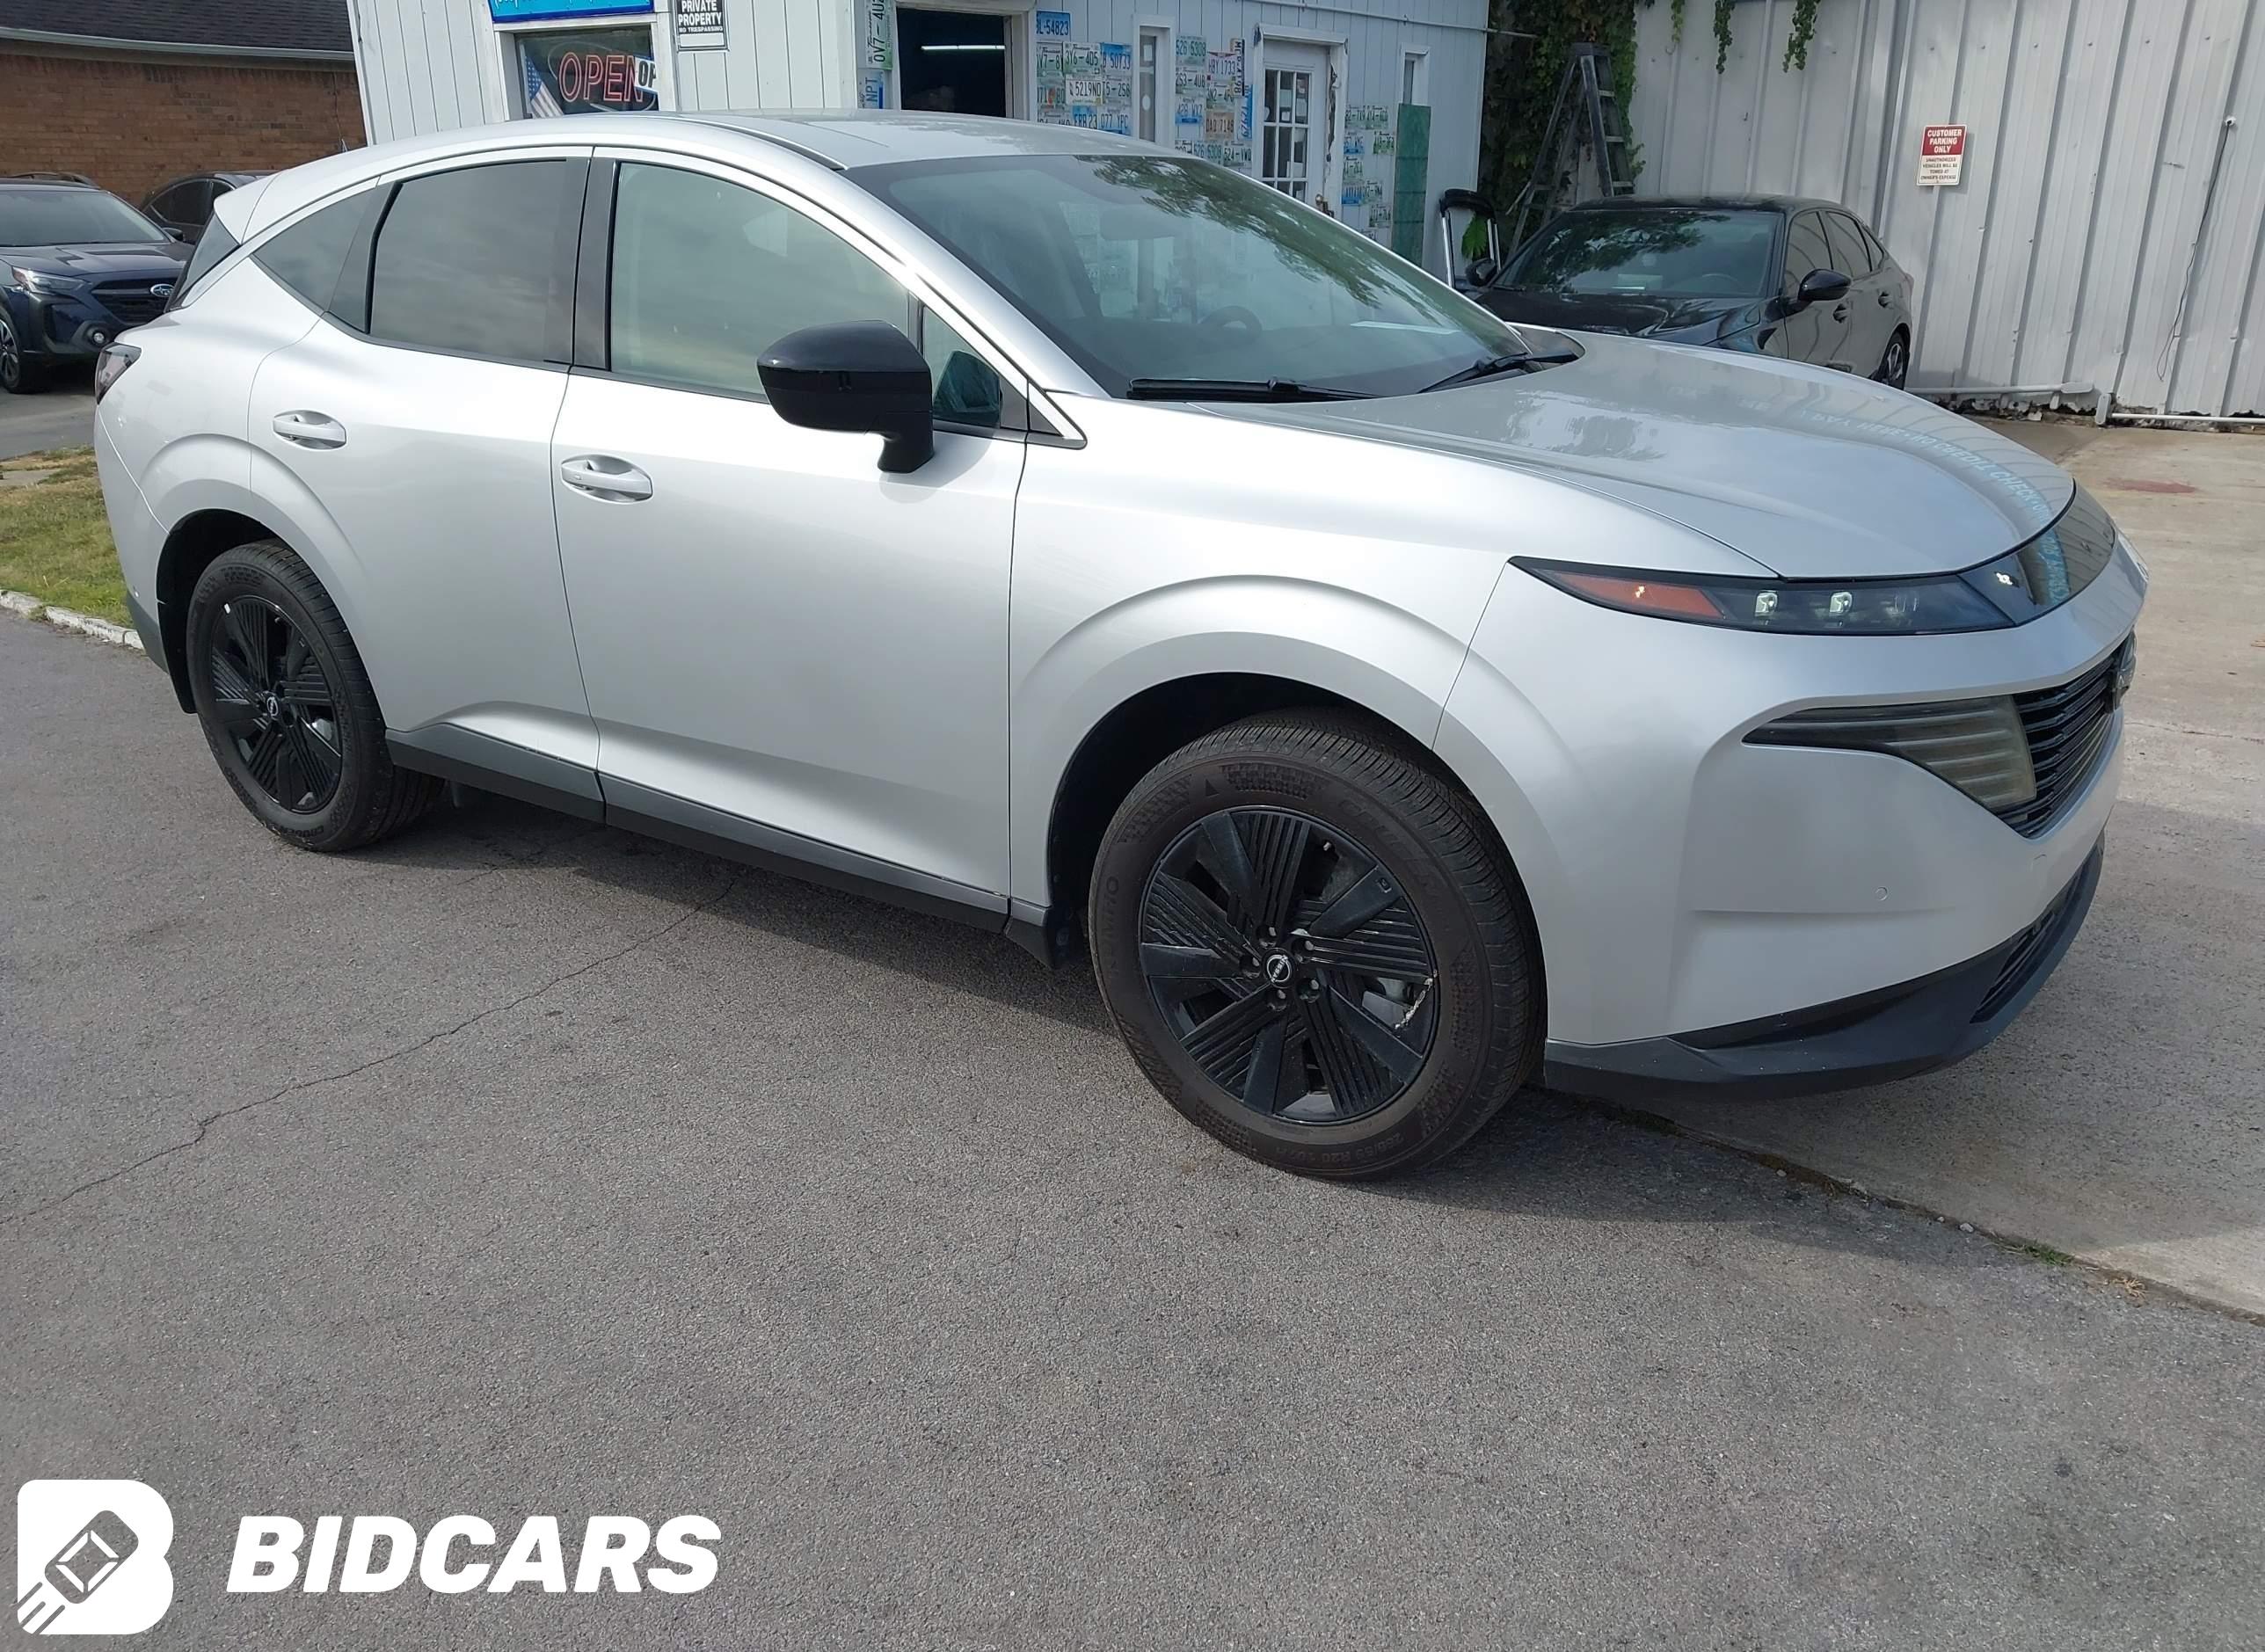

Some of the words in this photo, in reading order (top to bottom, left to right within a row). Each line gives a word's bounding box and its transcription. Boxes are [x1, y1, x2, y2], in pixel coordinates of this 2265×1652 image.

[681, 0, 717, 12] PRIVATE
[678, 12, 722, 25] PROPERTY
[559, 52, 643, 102] OPEN
